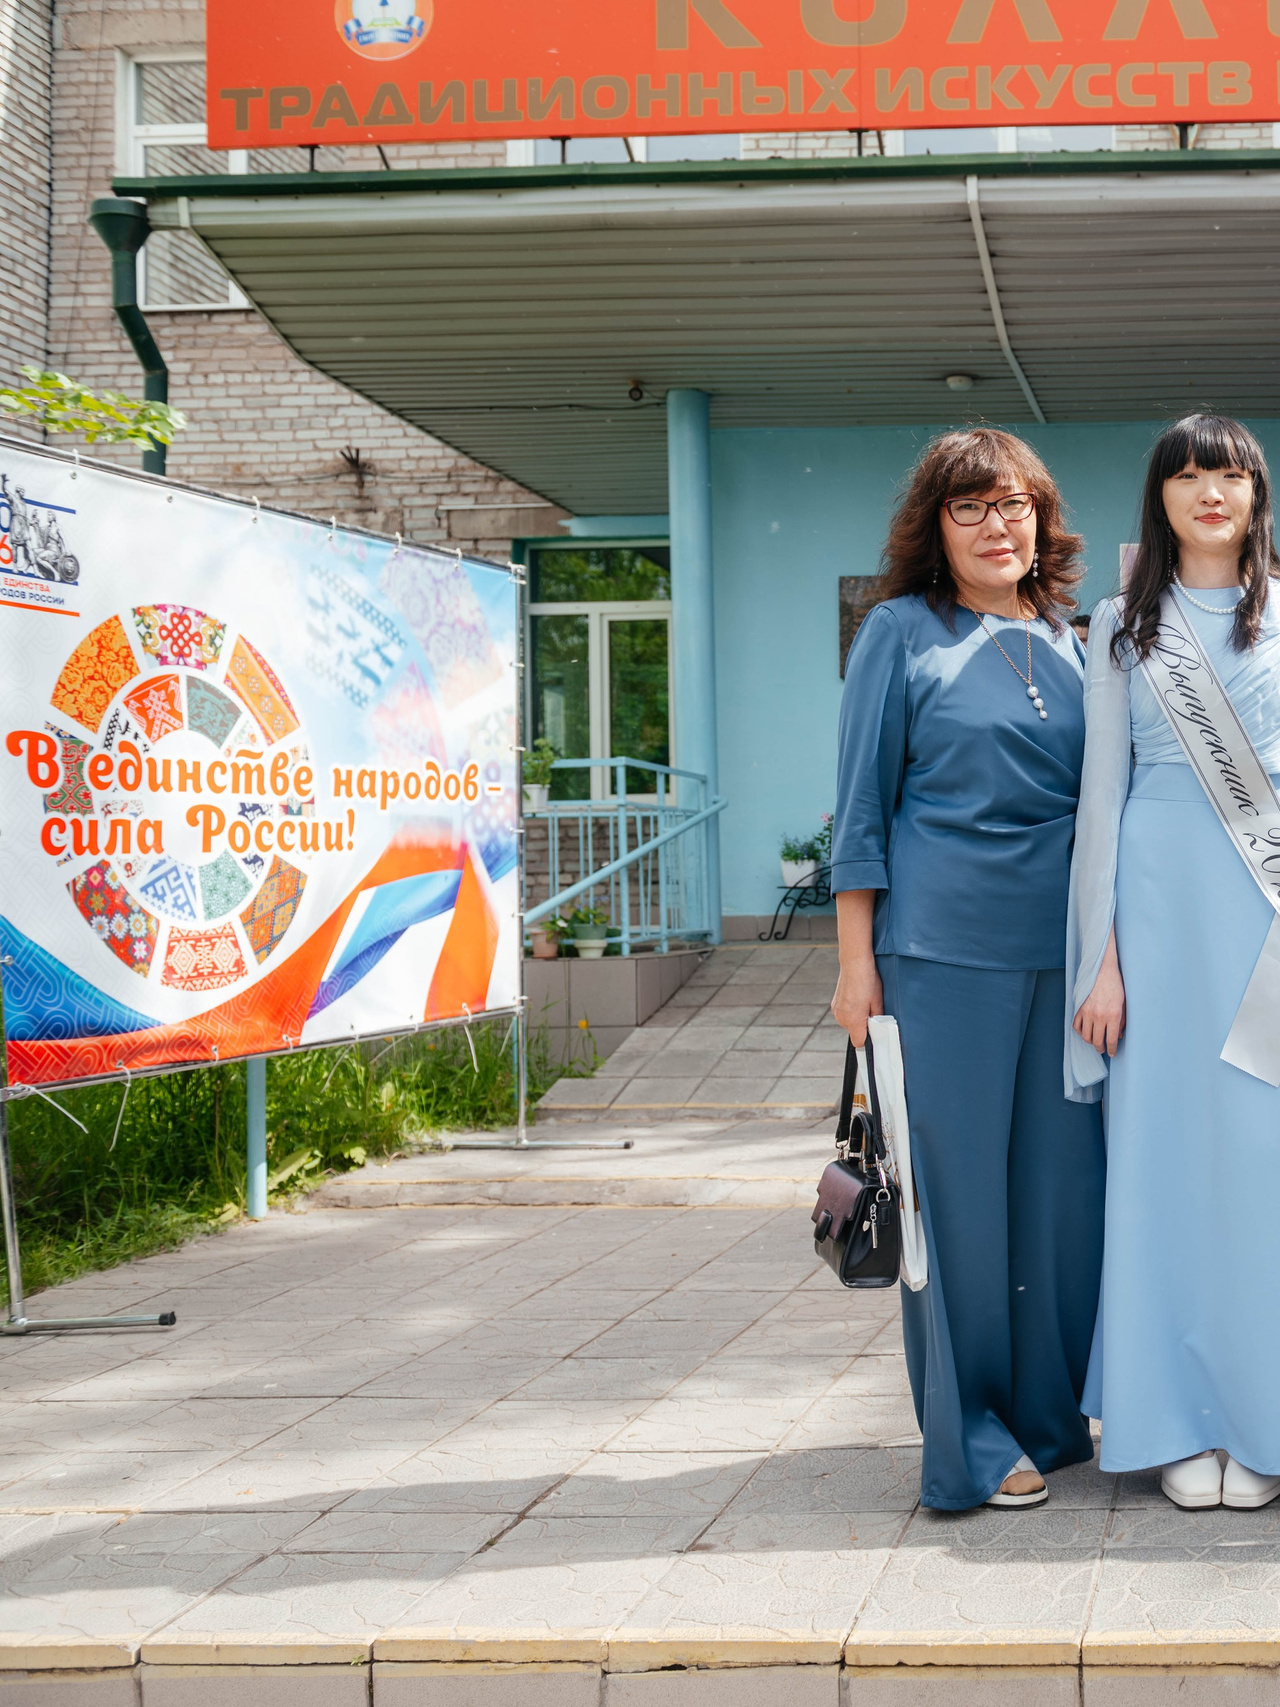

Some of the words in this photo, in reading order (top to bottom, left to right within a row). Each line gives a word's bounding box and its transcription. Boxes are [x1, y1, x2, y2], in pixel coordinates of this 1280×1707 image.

[220, 68, 856, 131] ТРАДИЦИОННЫХ
[874, 60, 1253, 113] ИСКУССТВ
[0, 587, 26, 599] ОДОВ
[29, 592, 65, 605] РОССИИ
[3, 577, 51, 592] ЕДИНСТВА
[1153, 623, 1260, 817] Выпускник
[6, 730, 60, 789] В
[88, 740, 314, 797] единстве
[41, 817, 165, 856] сила
[186, 803, 356, 853] России!
